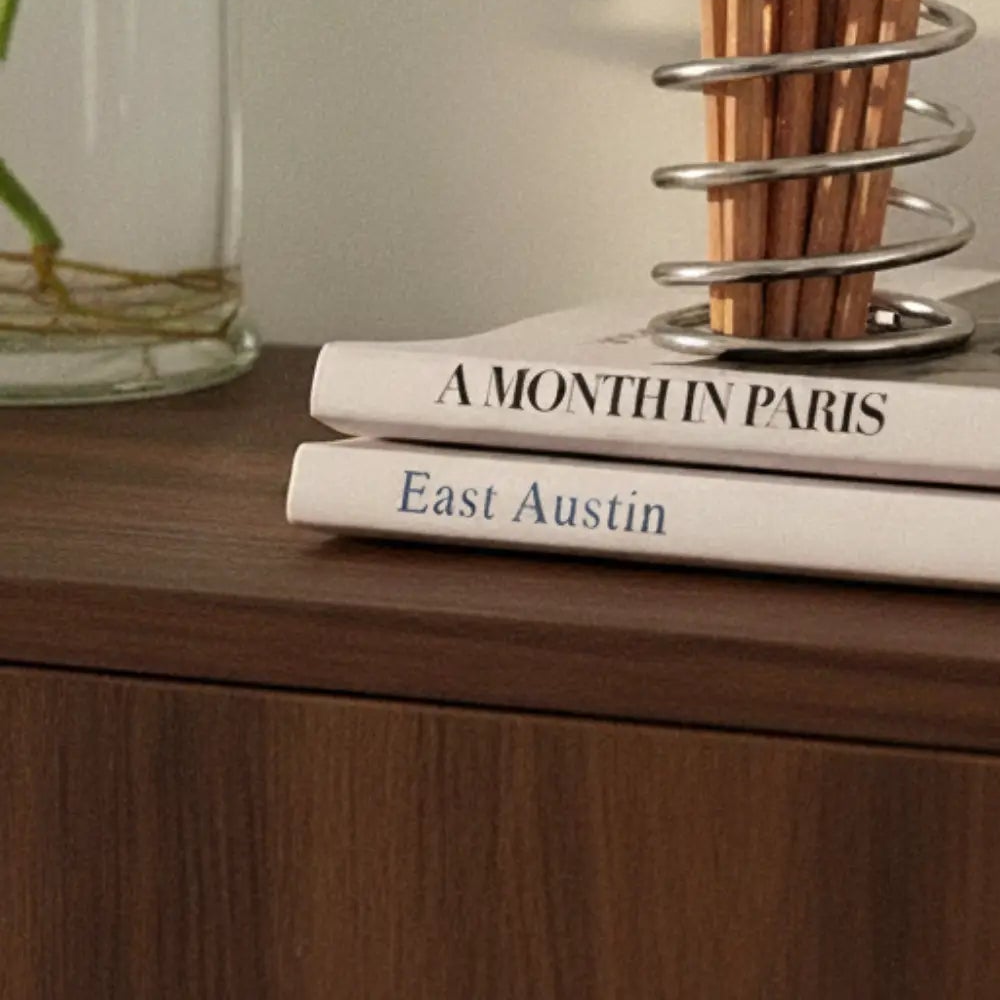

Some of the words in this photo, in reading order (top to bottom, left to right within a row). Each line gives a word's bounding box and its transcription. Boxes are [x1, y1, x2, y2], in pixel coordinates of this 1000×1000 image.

[435, 362, 474, 407] A
[483, 366, 671, 422] MONTH
[681, 379, 735, 425] IN
[743, 383, 888, 437] PARIS
[397, 469, 497, 521] East
[511, 481, 667, 536] Austin
